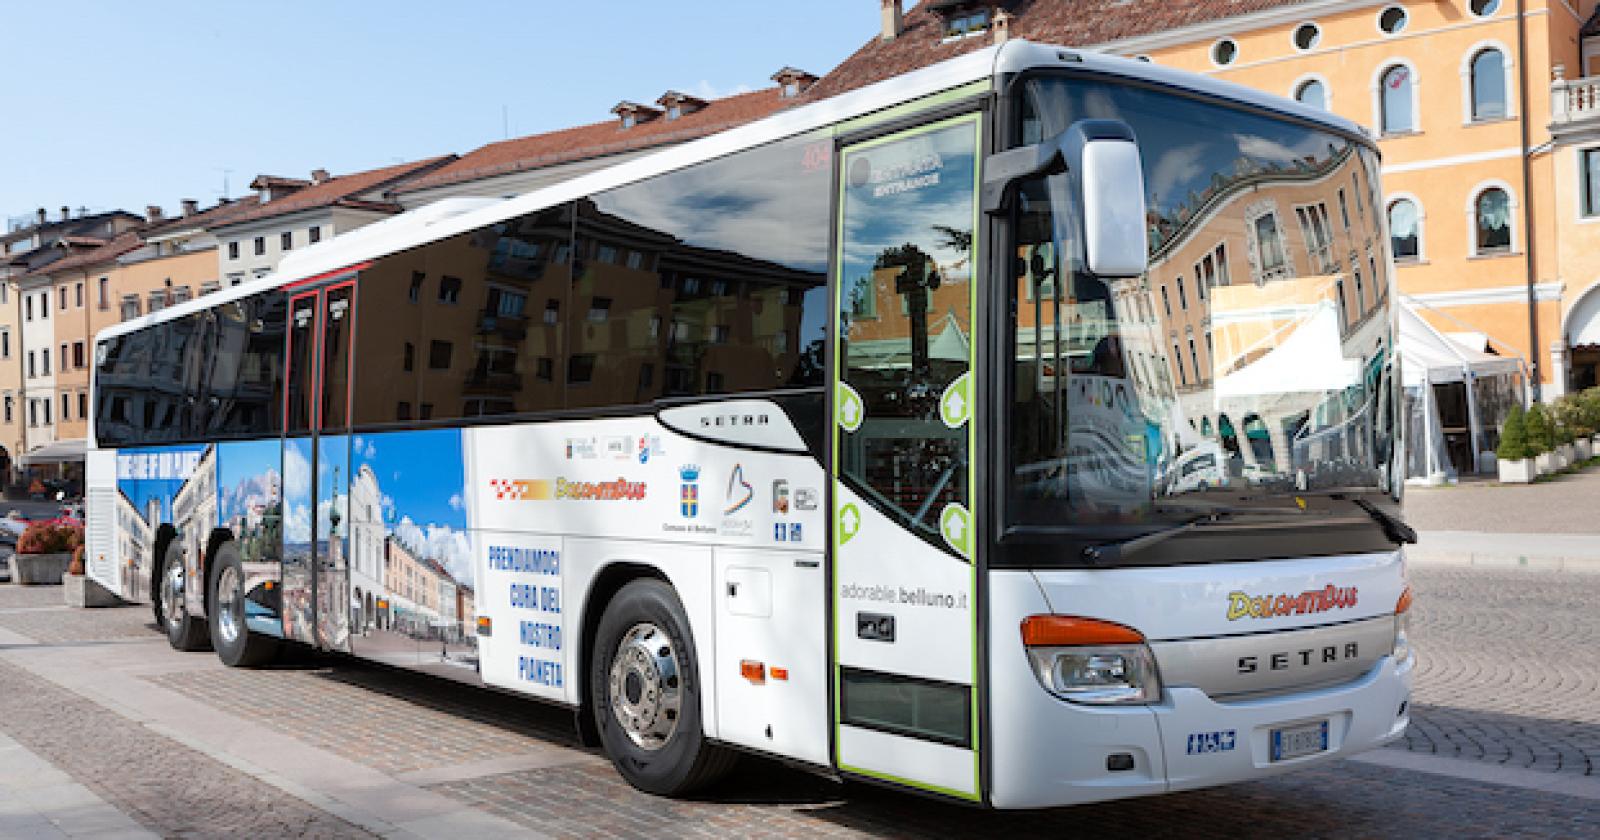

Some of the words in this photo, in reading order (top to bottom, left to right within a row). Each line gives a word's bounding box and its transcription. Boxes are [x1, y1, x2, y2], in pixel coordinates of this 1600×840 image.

[700, 414, 769, 428] SETRA
[488, 545, 560, 575] PRENDIAMOCI
[510, 584, 538, 610] CURA
[541, 587, 561, 614] DEL
[840, 582, 968, 610] adorable.belluno.it
[520, 620, 562, 650] NOSTRO
[518, 656, 563, 688] PIANETA
[1237, 641, 1359, 675] SETRA
